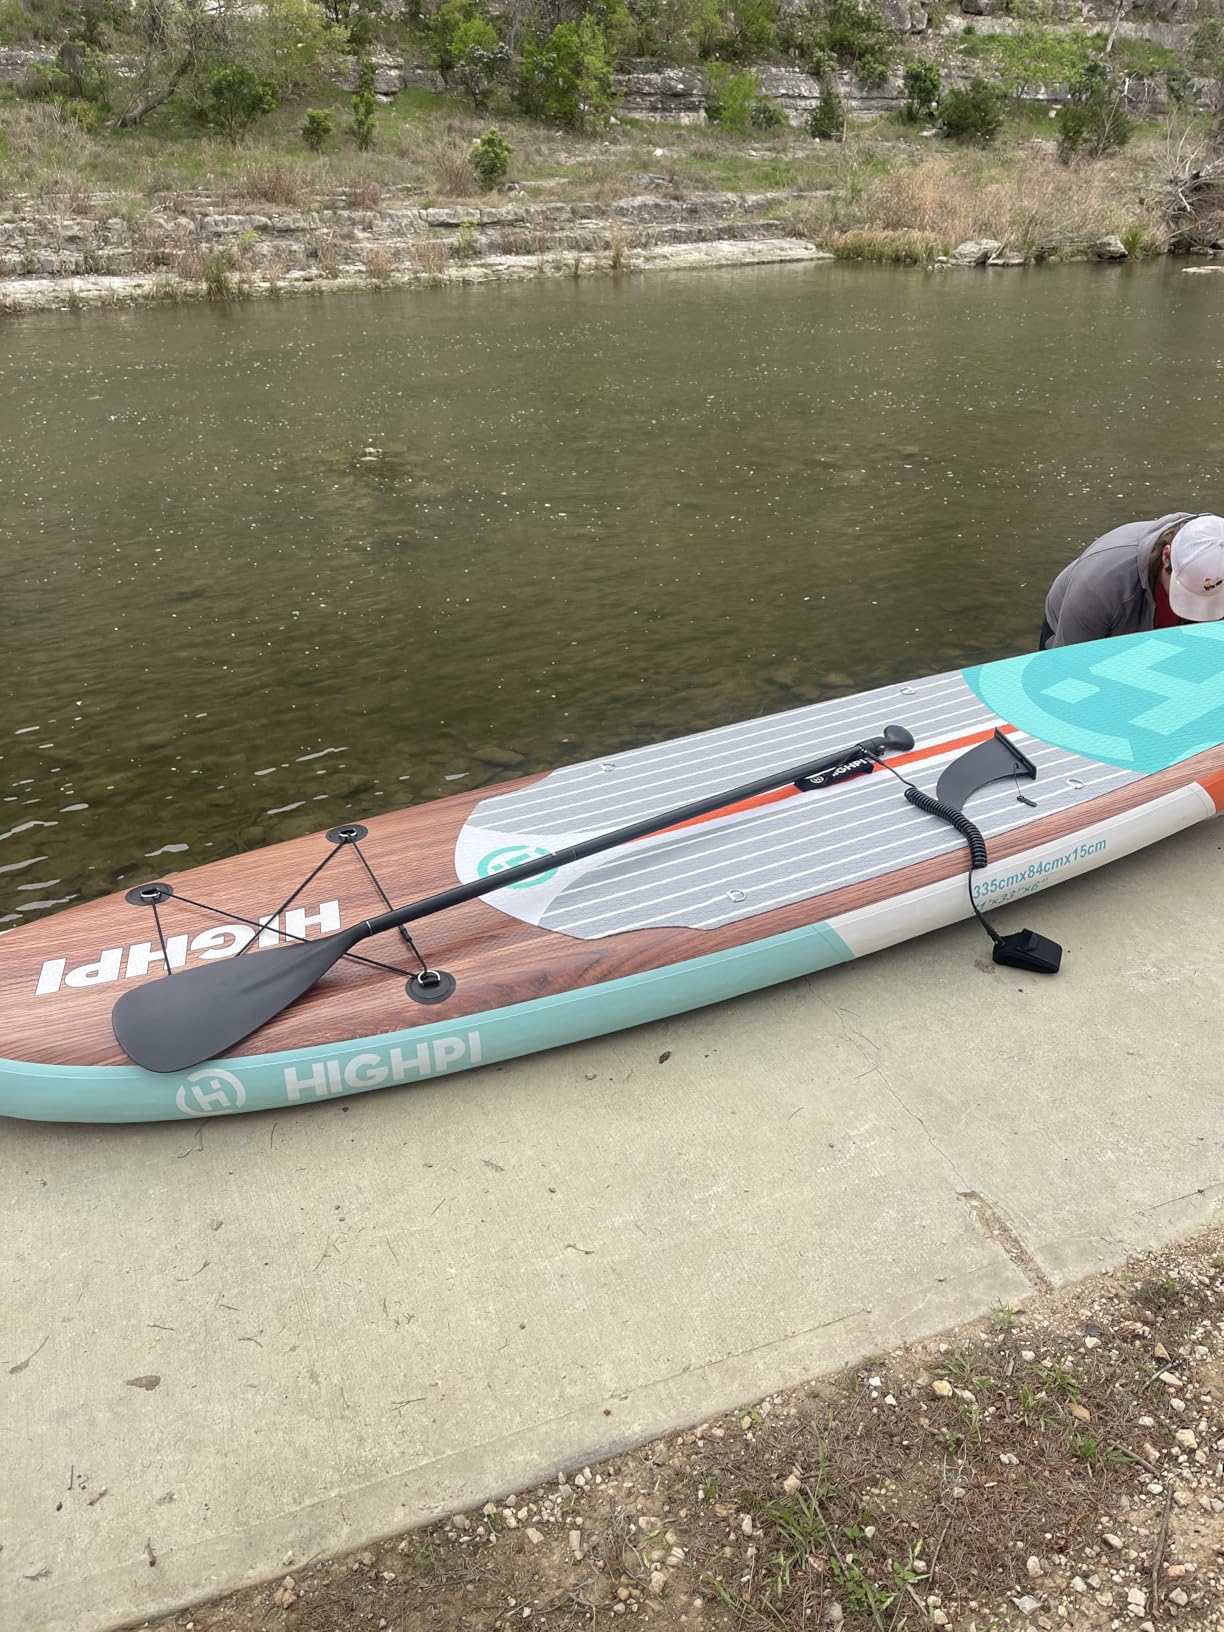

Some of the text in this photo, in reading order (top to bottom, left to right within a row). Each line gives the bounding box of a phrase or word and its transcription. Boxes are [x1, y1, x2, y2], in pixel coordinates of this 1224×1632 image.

[832, 758, 867, 777] IGHPI
[973, 839, 1106, 899] 335cmx84cmx15cm
[34, 900, 342, 996] HIGHPI
[283, 1031, 482, 1101] HIGHPI
